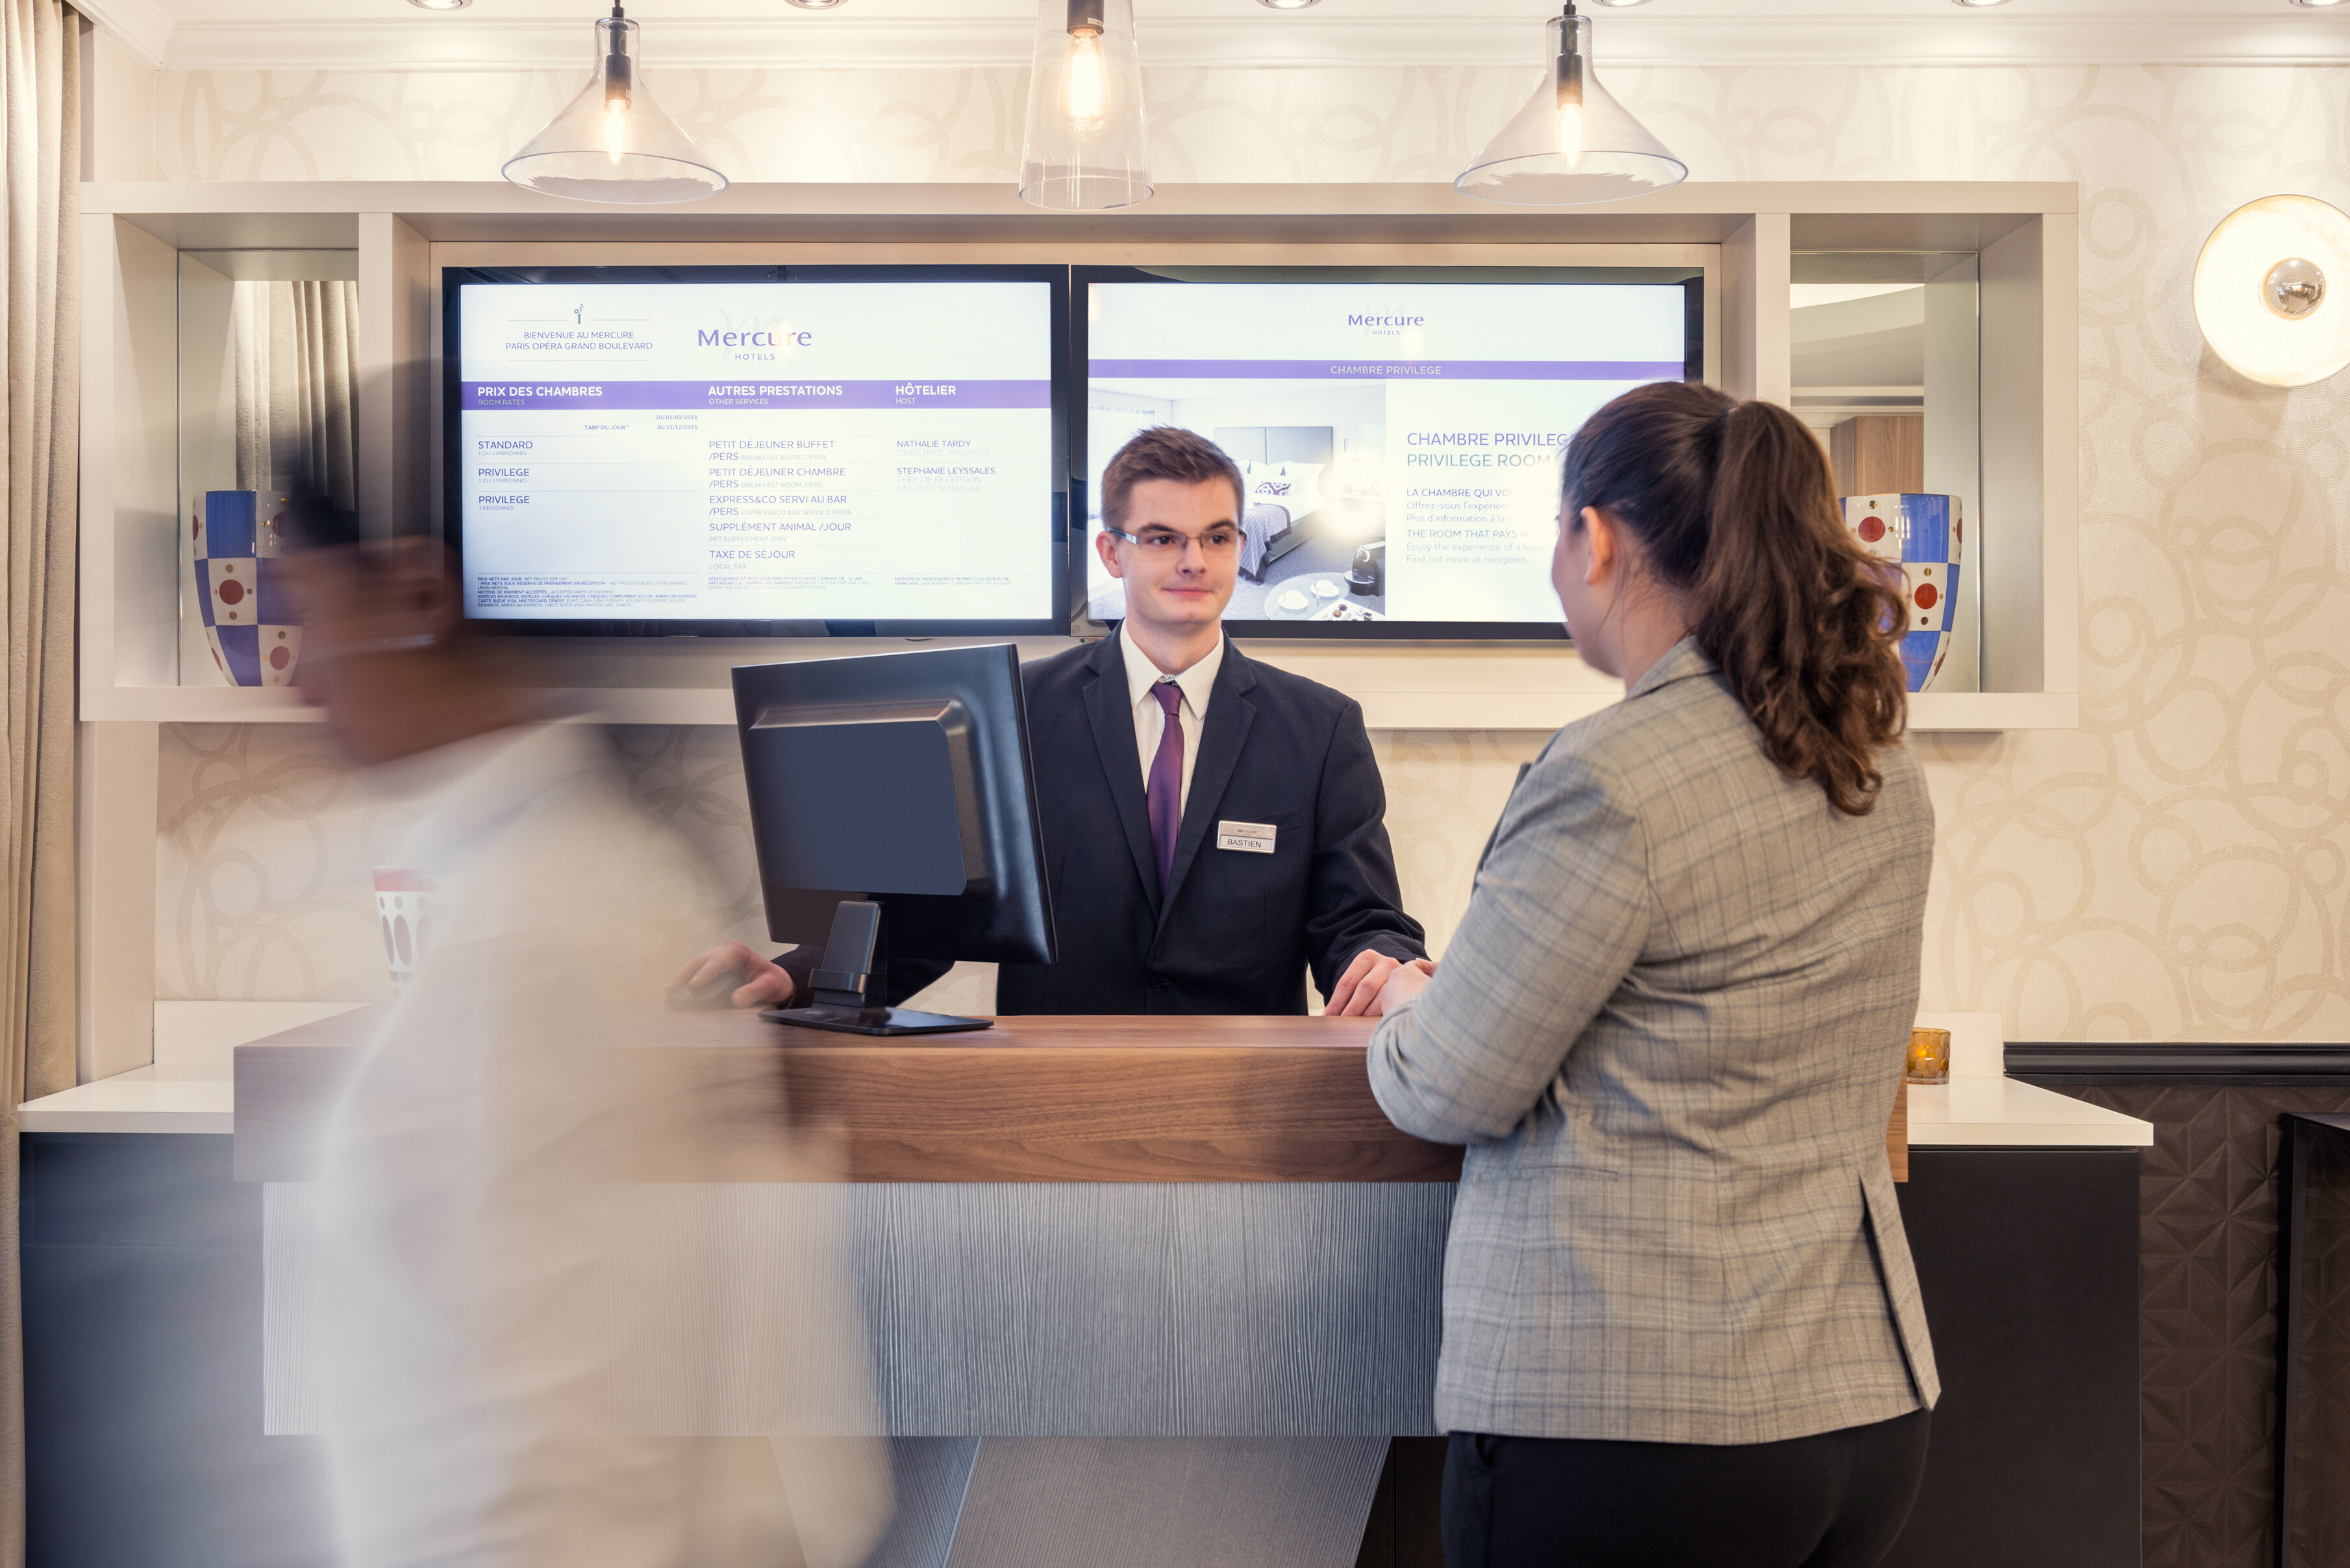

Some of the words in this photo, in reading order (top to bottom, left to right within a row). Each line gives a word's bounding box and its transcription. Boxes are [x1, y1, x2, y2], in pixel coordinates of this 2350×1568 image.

[1349, 314, 1424, 327] Mercure
[698, 329, 812, 346] Mercure
[532, 340, 562, 350] OPÉRA
[1330, 365, 1382, 375] CHAMBRE
[1386, 365, 1442, 375] PRIVILEGE
[477, 386, 506, 397] PRIX
[510, 386, 532, 397] DES
[536, 386, 603, 397] CHAMBRES
[708, 386, 755, 396] AUTRES
[760, 386, 843, 396] PRESTATIONS
[895, 382, 956, 395] HÔTELIER
[740, 438, 795, 449] DÉJEUNER
[1407, 432, 1488, 446] CHAMBRE
[1495, 432, 1568, 446] PRIVILEG
[478, 441, 533, 449] STANDARD
[709, 453, 738, 461] /PERS
[1407, 454, 1492, 467] PRIVILEGE
[1498, 454, 1551, 467] ROOM
[479, 468, 530, 477] PRIVILEGE
[740, 466, 794, 476] DÉJEUNER
[709, 480, 739, 488] /PERS
[1474, 488, 1492, 498] QUI
[479, 495, 530, 504] PRIVILEGE
[709, 495, 776, 504] EXPRESS&CO
[779, 495, 807, 504] SERVI
[810, 495, 824, 504] AU
[827, 495, 847, 504] BAR
[1406, 501, 1462, 509] Offrez-vous
[1464, 501, 1513, 511] l'expérienc
[709, 507, 739, 516] /PERS
[1406, 514, 1425, 522] Plus
[1428, 514, 1487, 522] d'information
[1497, 514, 1505, 522] la
[1406, 530, 1426, 538] THE
[1430, 530, 1461, 538] ROOM
[1465, 530, 1489, 538] THAT
[1493, 530, 1517, 538] PAYS
[1406, 541, 1431, 553] Enjoy
[1434, 542, 1449, 551] the
[1451, 544, 1501, 553] experience
[1503, 542, 1514, 551] of
[709, 551, 735, 559] TAXE
[738, 551, 751, 559] DE
[755, 548, 795, 559] SÉJOUR
[1227, 838, 1262, 848] BASTIEN
